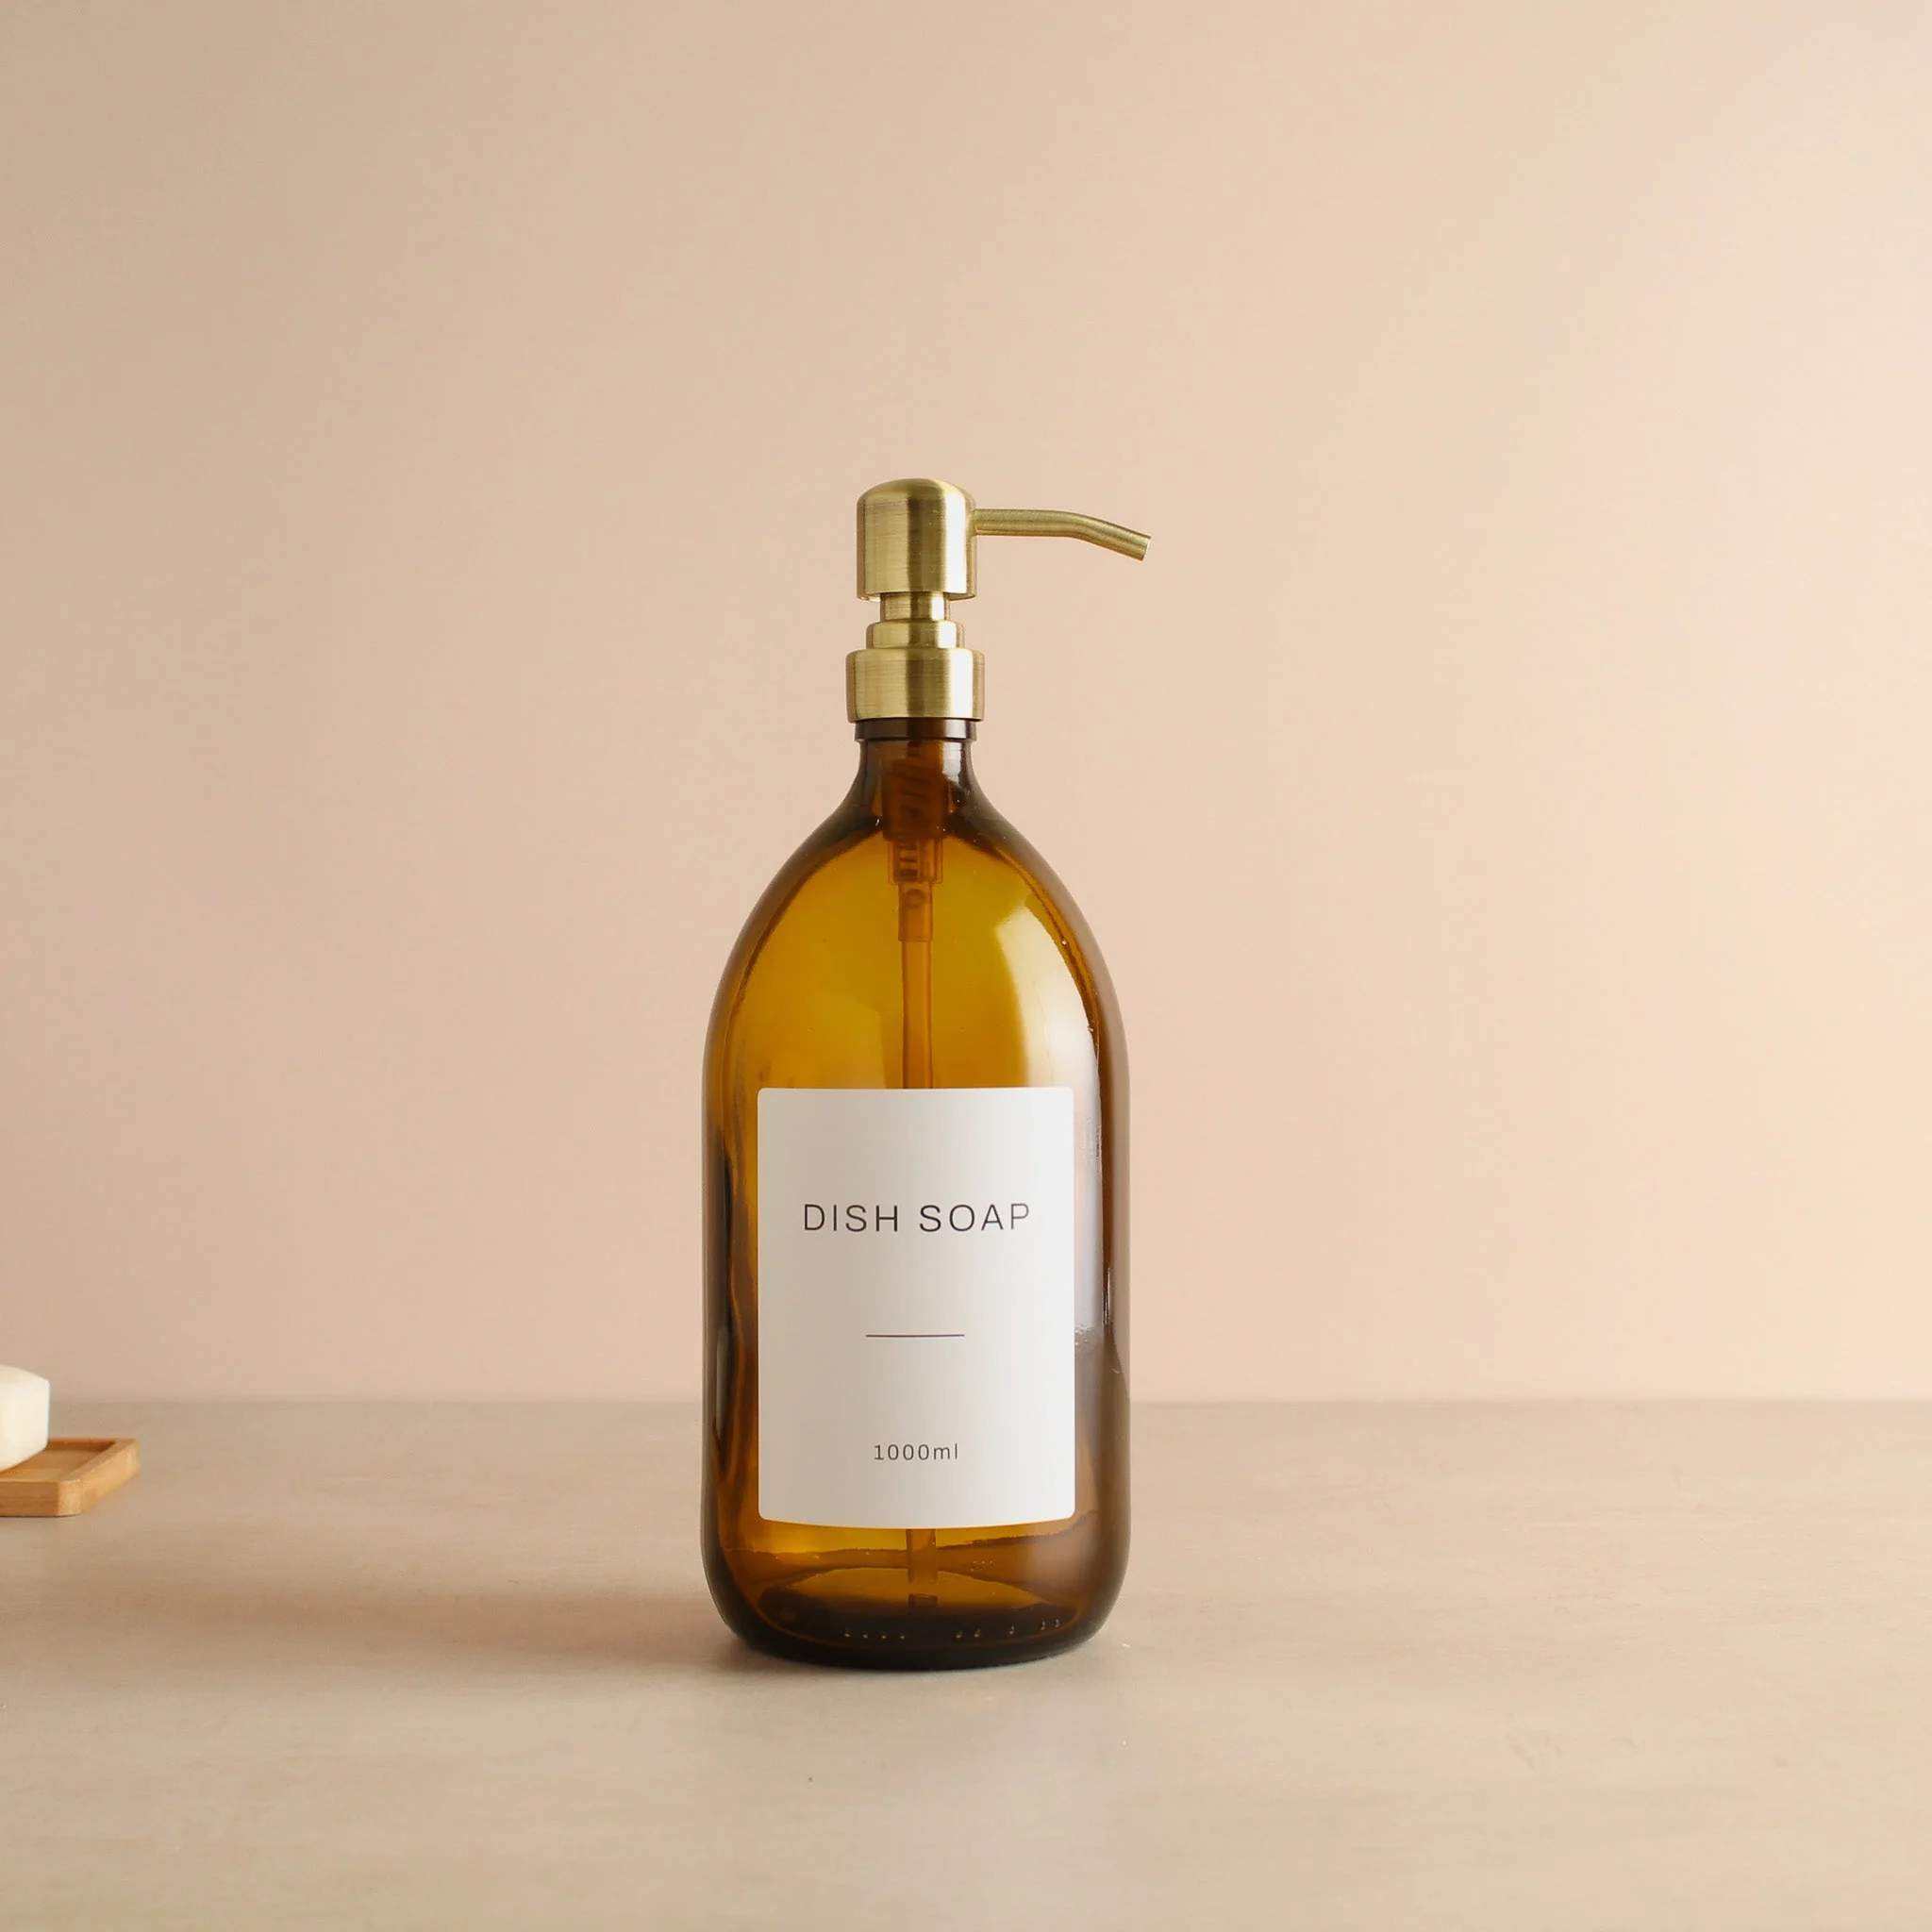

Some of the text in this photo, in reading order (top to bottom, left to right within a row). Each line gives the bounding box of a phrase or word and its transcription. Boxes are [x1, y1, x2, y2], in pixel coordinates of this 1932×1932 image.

[803, 1202, 1030, 1233] DISH SOAP
[873, 1442, 958, 1461] 1000ml
